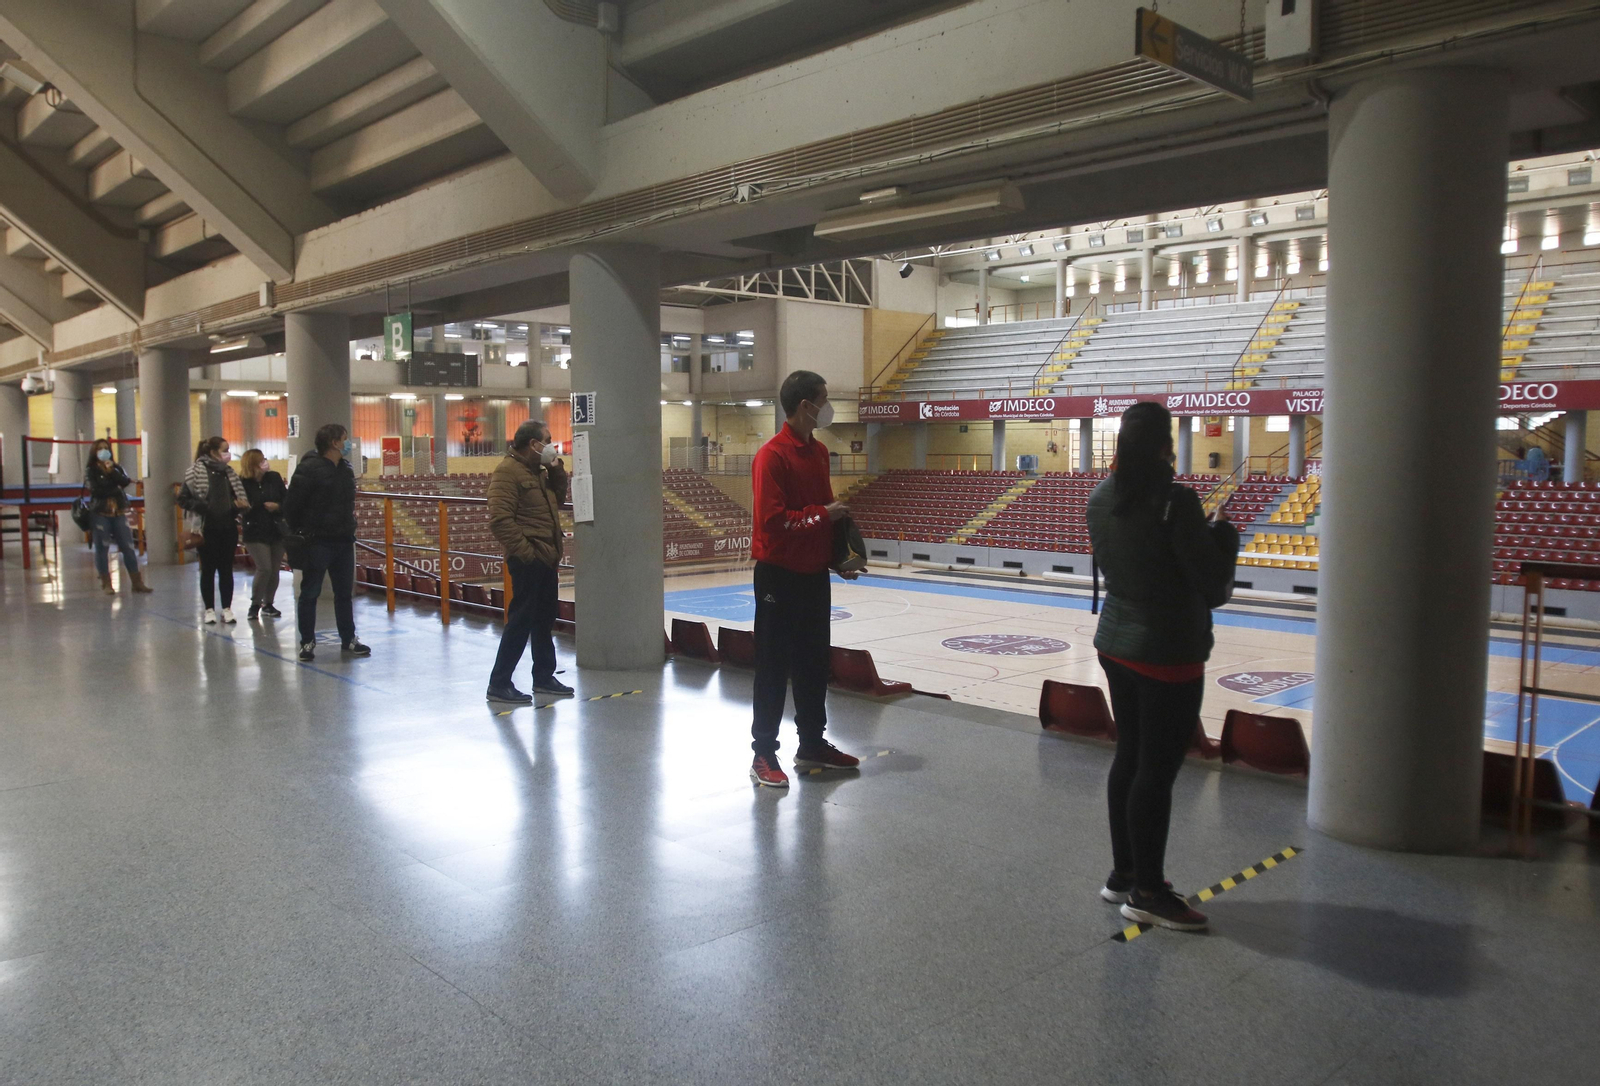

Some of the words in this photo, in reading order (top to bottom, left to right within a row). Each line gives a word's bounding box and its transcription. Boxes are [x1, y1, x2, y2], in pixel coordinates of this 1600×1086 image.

[1175, 34, 1224, 79] Servicios
[392, 322, 404, 354] B
[1003, 398, 1055, 412] IMDECO
[1185, 392, 1251, 408] IMDECO
[868, 405, 900, 414] IMDECO
[728, 536, 752, 549] IMD
